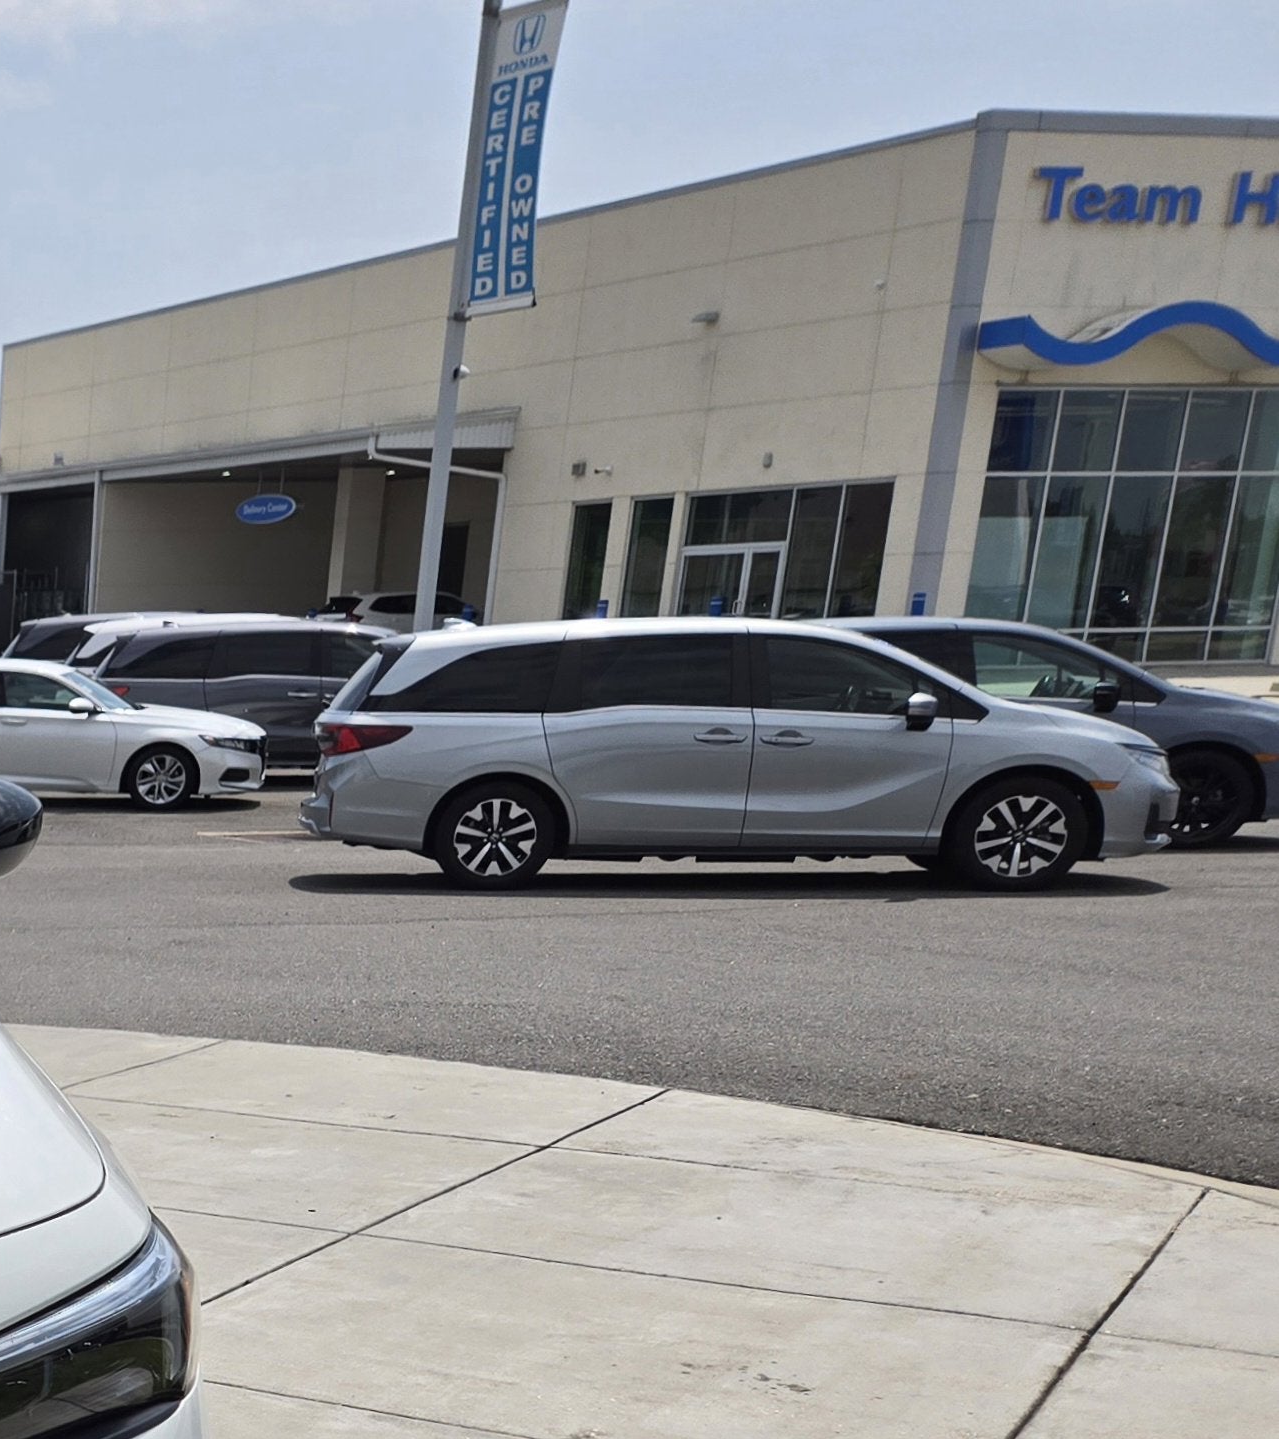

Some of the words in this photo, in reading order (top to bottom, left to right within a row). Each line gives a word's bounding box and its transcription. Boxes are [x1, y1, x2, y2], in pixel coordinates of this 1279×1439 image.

[497, 53, 550, 76] HONDA
[520, 75, 545, 146] PRE
[474, 84, 512, 297] CERTIFIED
[1035, 166, 1203, 223] Team
[510, 174, 534, 290] OWNED
